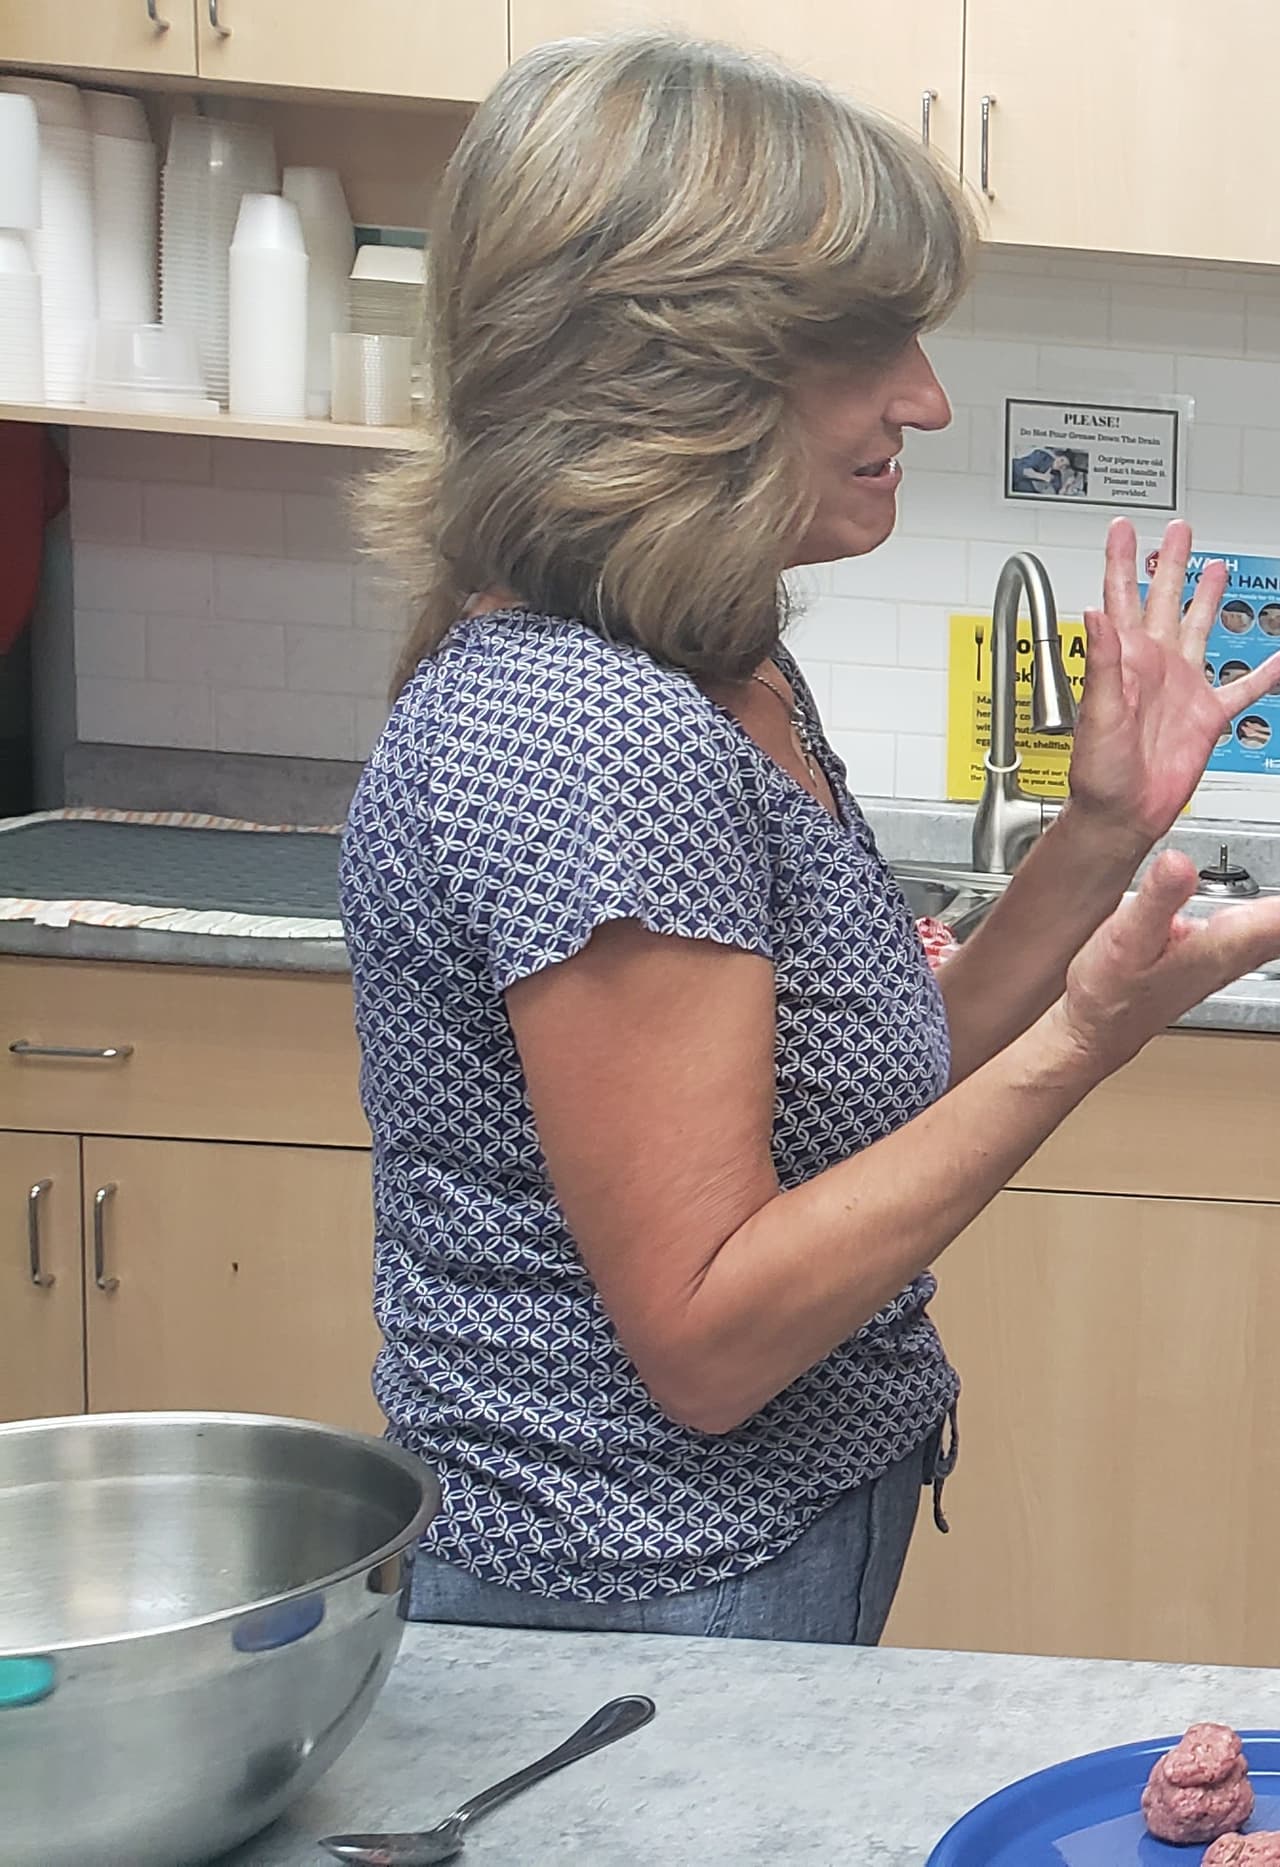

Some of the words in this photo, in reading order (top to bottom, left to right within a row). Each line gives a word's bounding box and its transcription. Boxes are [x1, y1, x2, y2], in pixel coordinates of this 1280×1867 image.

[1064, 413, 1120, 428] PLEASE!
[1020, 428, 1031, 436] Do
[1033, 429, 1047, 437] Not
[1049, 430, 1067, 438] Pour
[1069, 431, 1096, 441] Grease
[1098, 433, 1119, 442] Down
[1121, 435, 1137, 443] The
[1138, 436, 1161, 445] Drain
[1098, 454, 1113, 463] Our
[1185, 572, 1233, 587] YOR
[1033, 740, 1071, 751] shellfish
